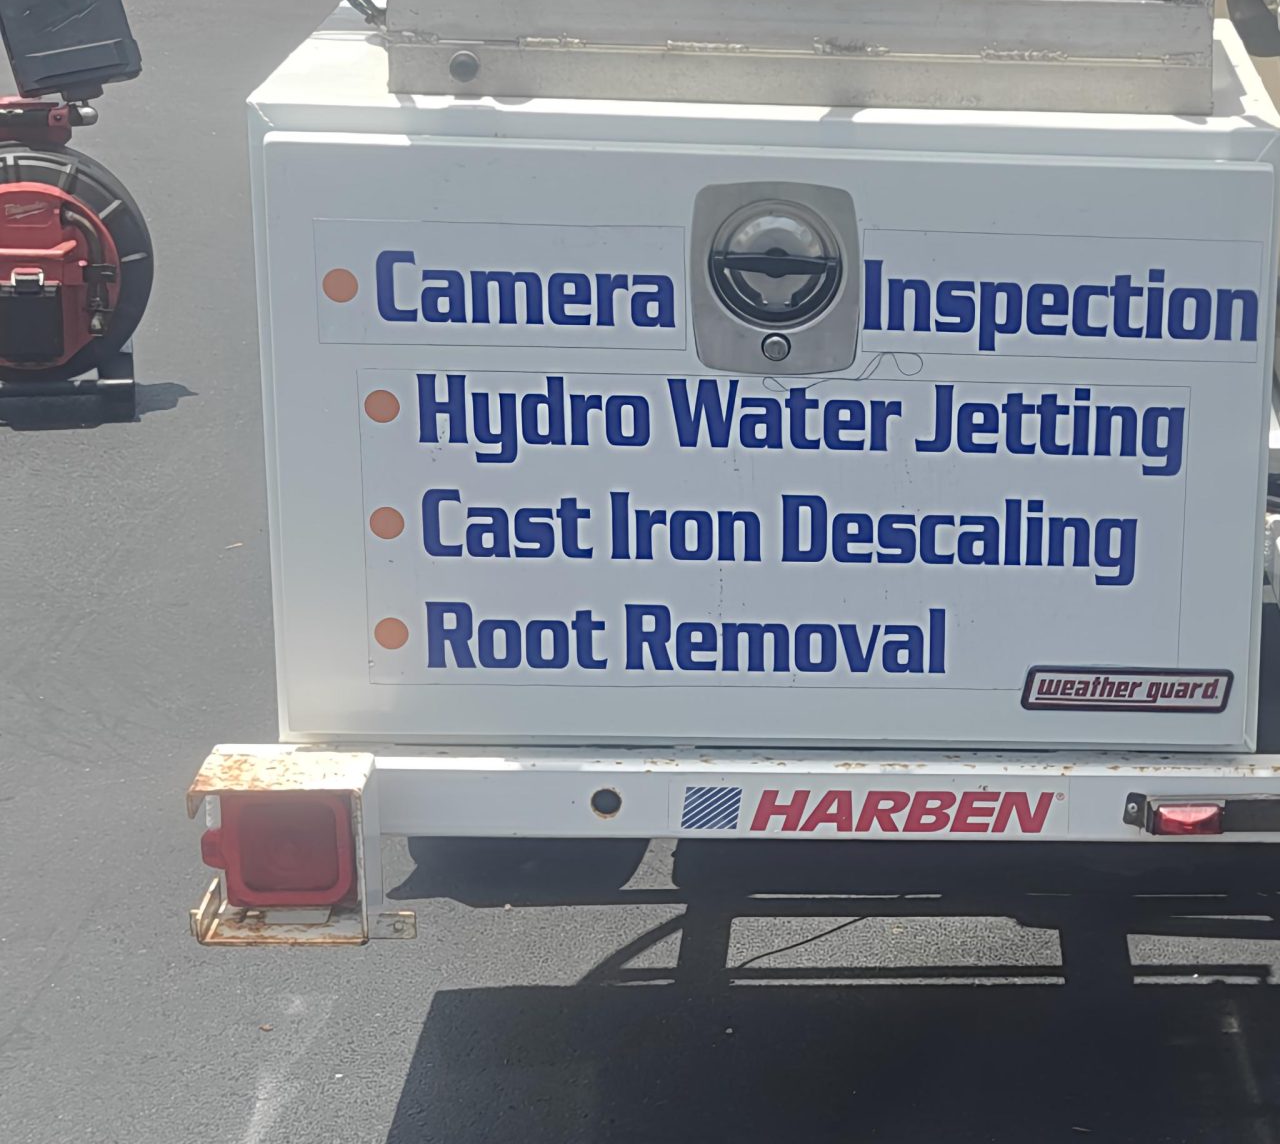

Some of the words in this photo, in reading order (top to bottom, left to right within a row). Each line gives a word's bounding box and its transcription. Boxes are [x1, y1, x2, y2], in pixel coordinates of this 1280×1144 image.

[376, 250, 676, 329] Camera
[863, 259, 1259, 352] Inspection
[416, 373, 651, 463] Hydro
[667, 378, 903, 452] Water
[914, 385, 1186, 477] Jetting
[421, 488, 594, 560] Cast
[609, 491, 762, 562] Iron
[780, 494, 1138, 586] Descaling
[426, 601, 609, 670] Root
[624, 604, 946, 674] Removal
[1036, 676, 1142, 699] weather
[1146, 679, 1220, 704] guard
[750, 790, 1054, 833] HARBEN
